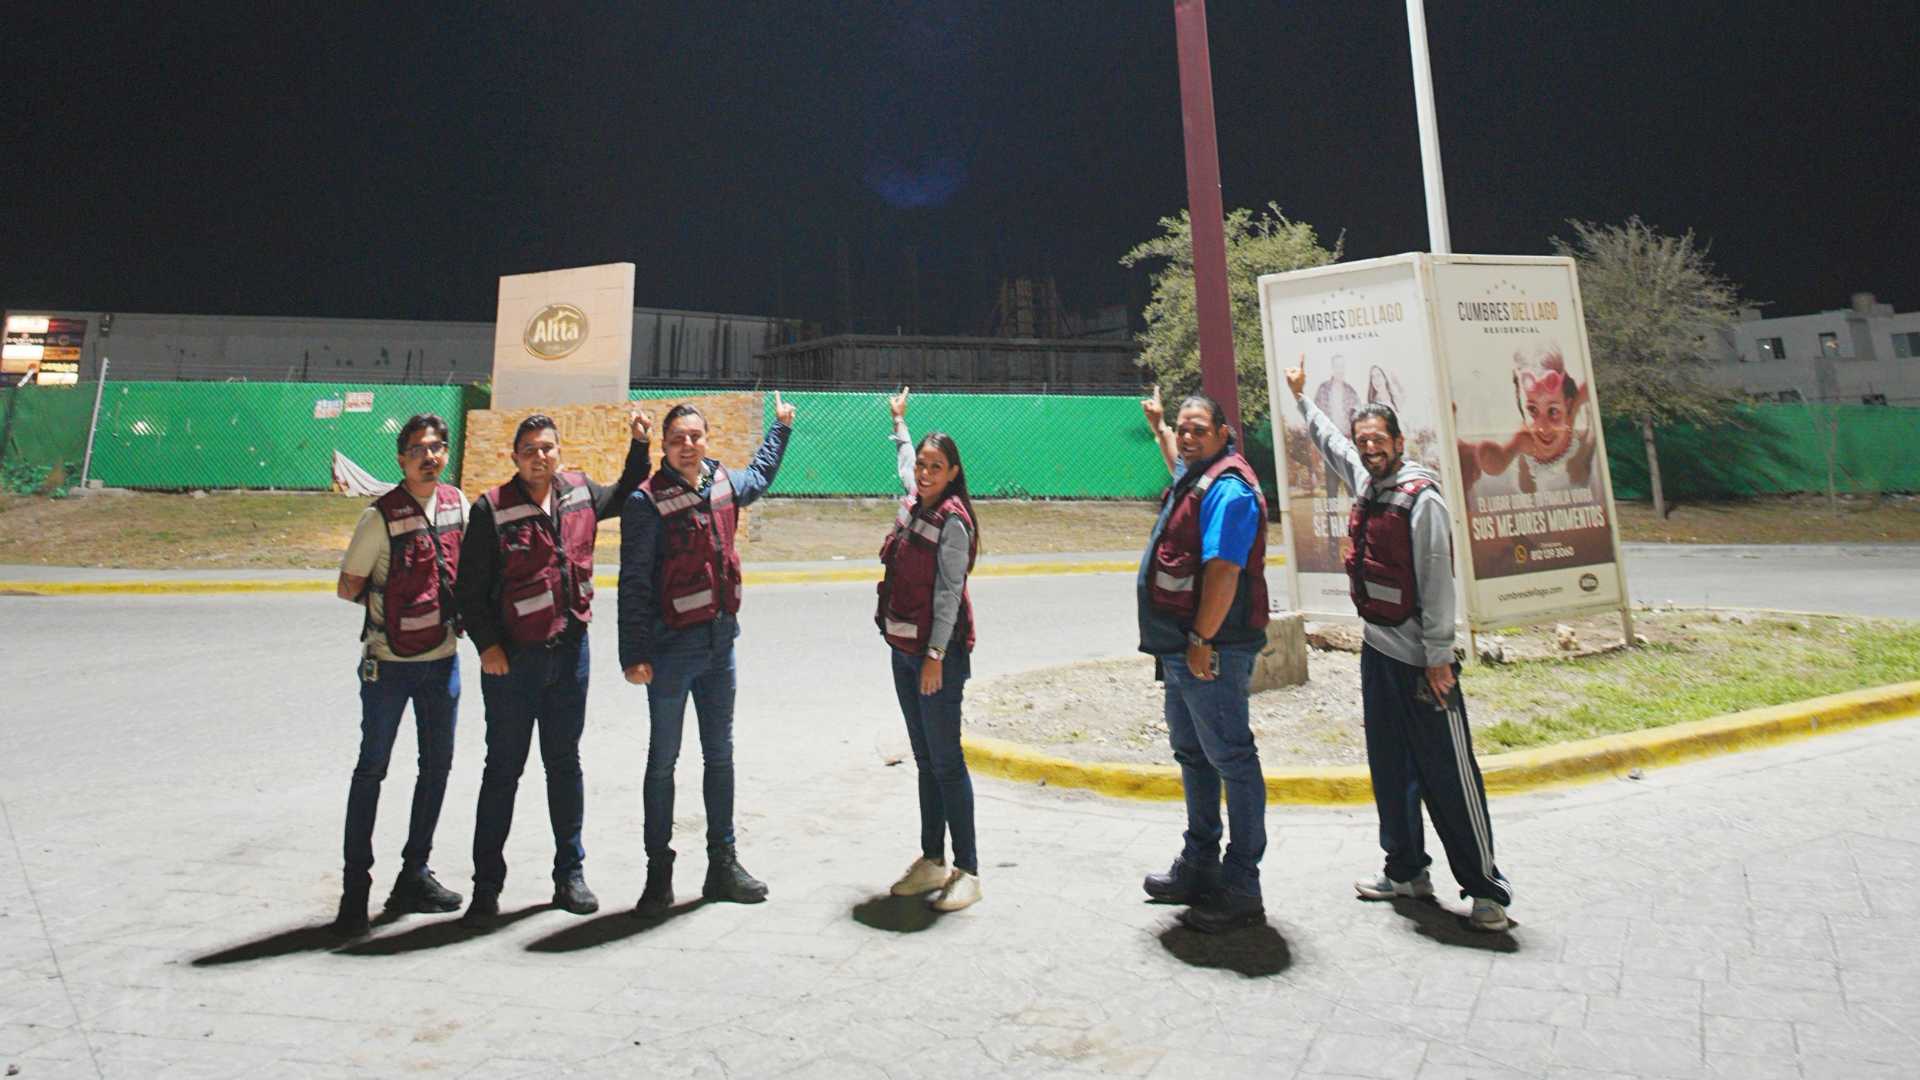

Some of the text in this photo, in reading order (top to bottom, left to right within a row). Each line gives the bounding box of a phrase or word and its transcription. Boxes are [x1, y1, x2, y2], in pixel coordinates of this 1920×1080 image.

[1291, 309, 1345, 334] CUMBRES
[1457, 301, 1510, 321] CUMBRES
[534, 319, 579, 342] Altta
[1316, 331, 1380, 343] RESIDENCIAL
[1483, 326, 1540, 335] RESIDENCIAL
[1472, 505, 1605, 540] SUS MEJORES MOMENTOS
